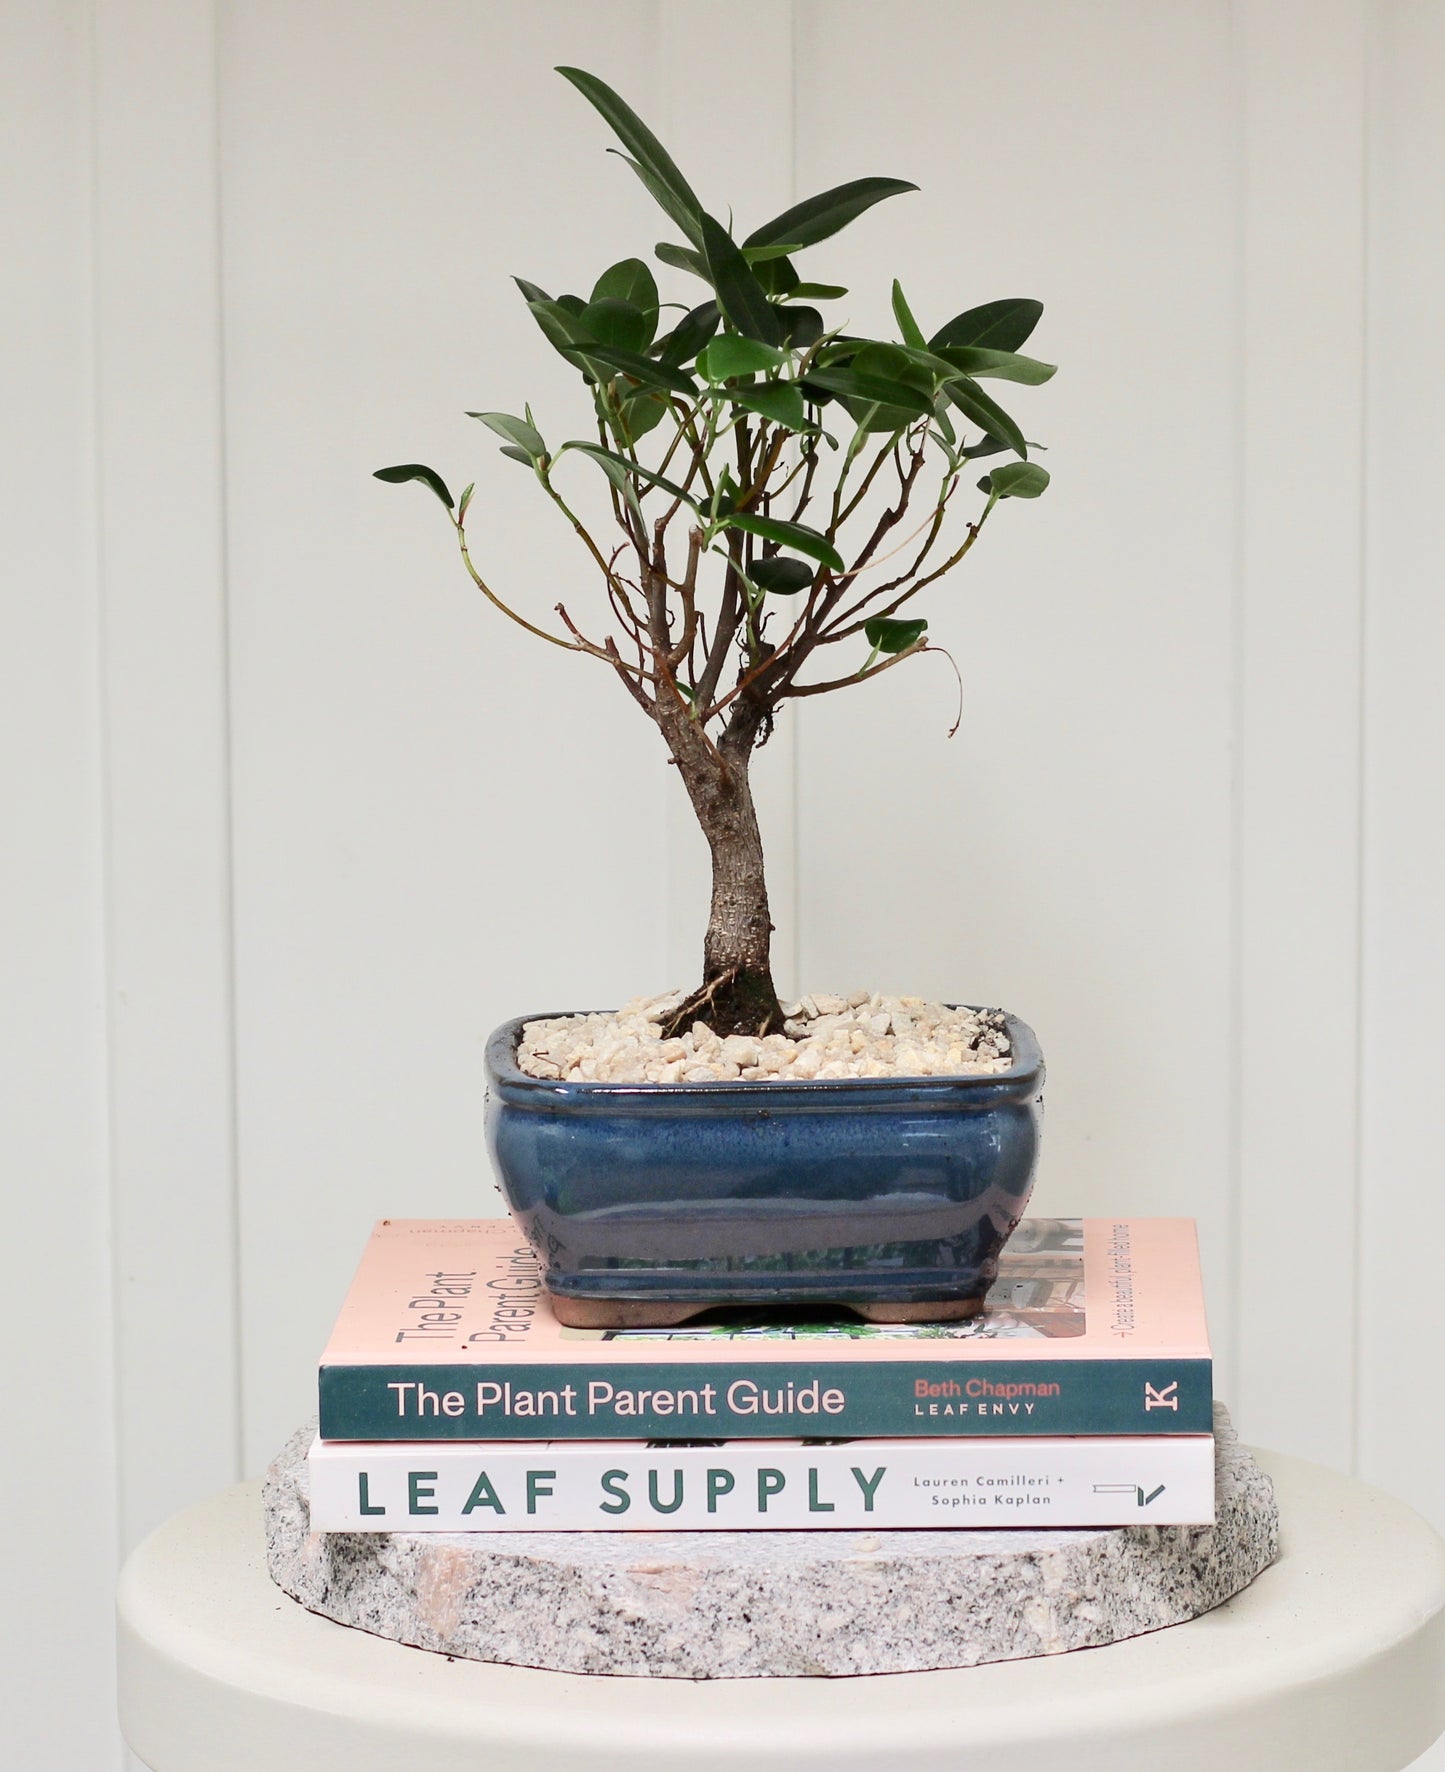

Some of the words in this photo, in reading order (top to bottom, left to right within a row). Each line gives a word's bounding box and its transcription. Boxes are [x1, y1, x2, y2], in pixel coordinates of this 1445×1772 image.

[408, 1271, 477, 1309] Plant
[396, 1313, 463, 1343] The
[468, 1293, 541, 1342] Parent
[387, 1381, 466, 1418] The
[477, 1381, 578, 1417] Plant
[588, 1381, 717, 1416] Parent
[727, 1379, 846, 1416] Guide
[914, 1379, 961, 1398] Beth
[966, 1378, 1061, 1400] Chapman
[1144, 1380, 1178, 1412] K
[914, 1403, 969, 1416] LEAF
[978, 1402, 1035, 1416] ENVY
[358, 1469, 557, 1516] LEAF
[598, 1466, 887, 1515] SUPPLY
[914, 1476, 969, 1487] Lauren
[976, 1475, 1049, 1486] Camilleri
[931, 1494, 987, 1508] Sophia
[994, 1493, 1051, 1508] Kaplan
